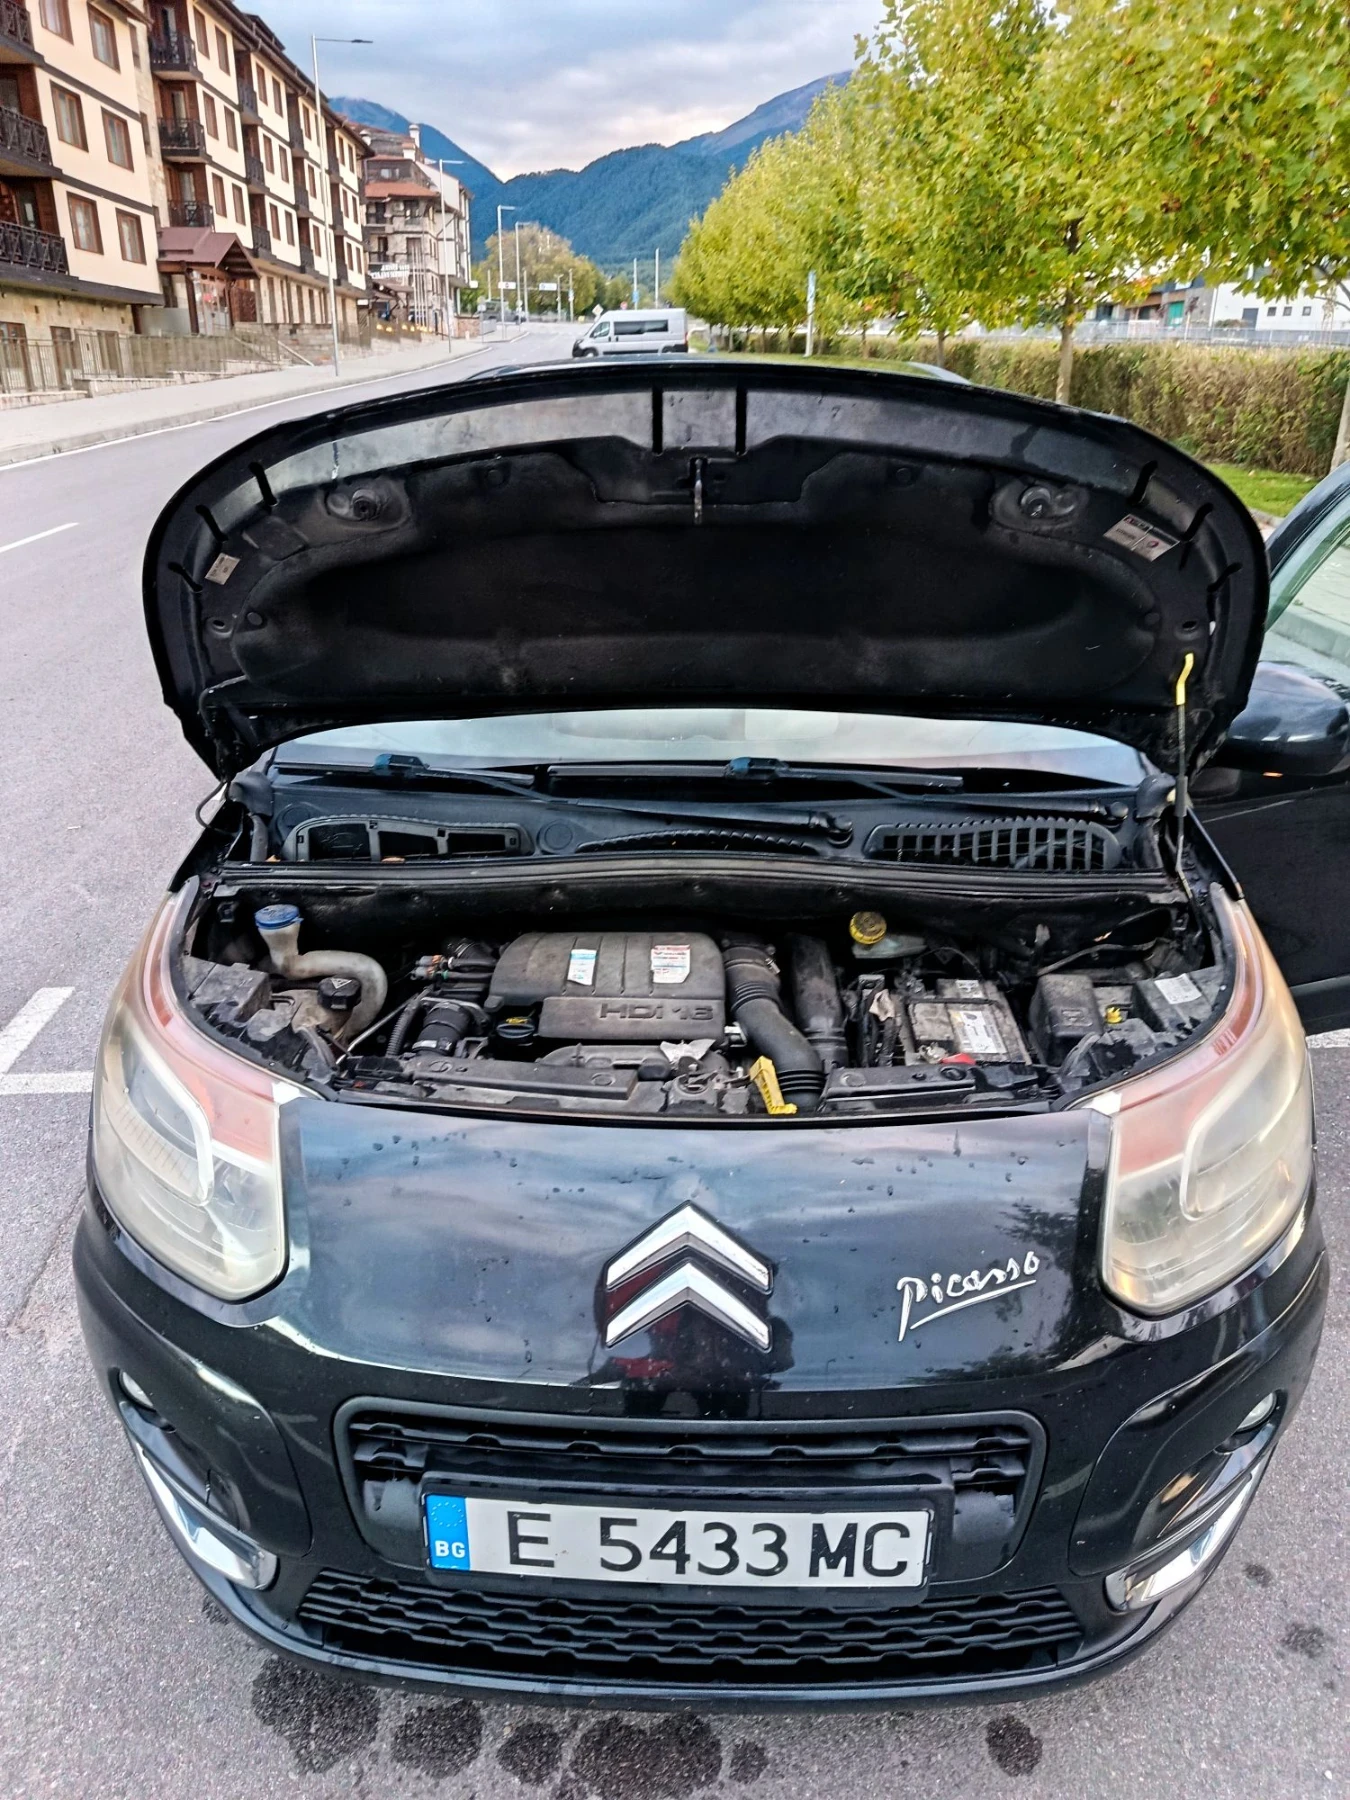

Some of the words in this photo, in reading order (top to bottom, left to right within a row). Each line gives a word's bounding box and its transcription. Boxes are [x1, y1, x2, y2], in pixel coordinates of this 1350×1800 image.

[434, 1540, 466, 1558] BG
[507, 1510, 555, 1568] E
[599, 1516, 789, 1577] 5433
[808, 1521, 911, 1577] MC
